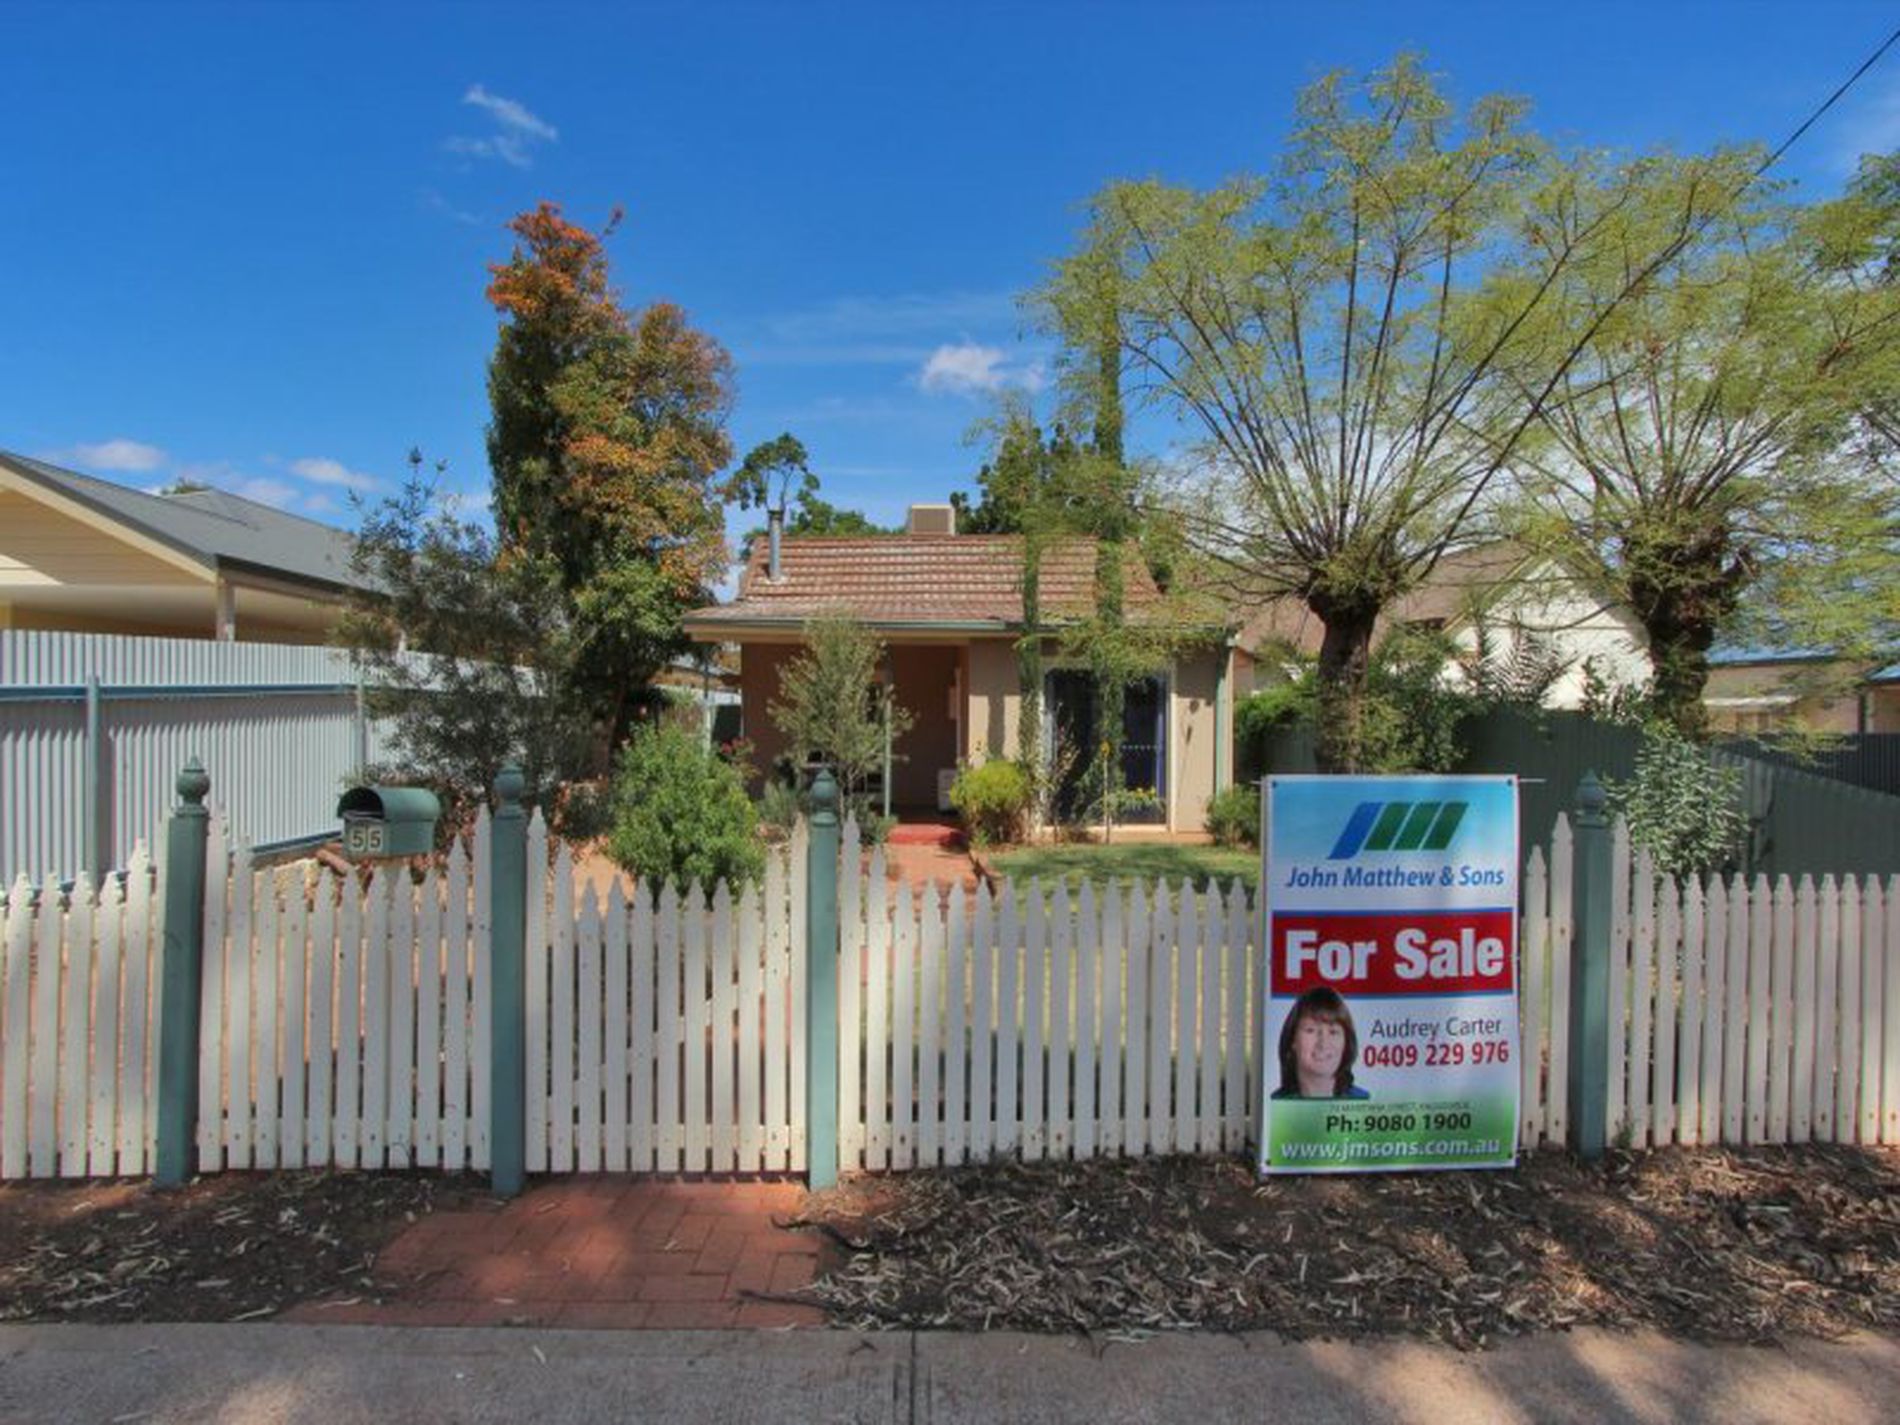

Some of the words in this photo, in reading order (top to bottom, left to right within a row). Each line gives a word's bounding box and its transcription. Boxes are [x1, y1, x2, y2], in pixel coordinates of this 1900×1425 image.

[1286, 867, 1337, 888] John
[1343, 867, 1435, 887] Matthew
[1439, 867, 1455, 886] &
[1458, 865, 1505, 886] Sons
[1285, 930, 1377, 980] For
[1394, 928, 1504, 979] Sale
[1370, 1019, 1439, 1041] Audrey
[1445, 1017, 1501, 1036] Carter
[1363, 1045, 1418, 1067] 0409
[1425, 1043, 1464, 1065] 229
[1472, 1041, 1509, 1064] 976
[1326, 1114, 1360, 1132] Ph:
[1364, 1115, 1416, 1132] 9080
[1422, 1113, 1472, 1131] 1900
[1280, 1137, 1500, 1162] www.jmsons.com.au
